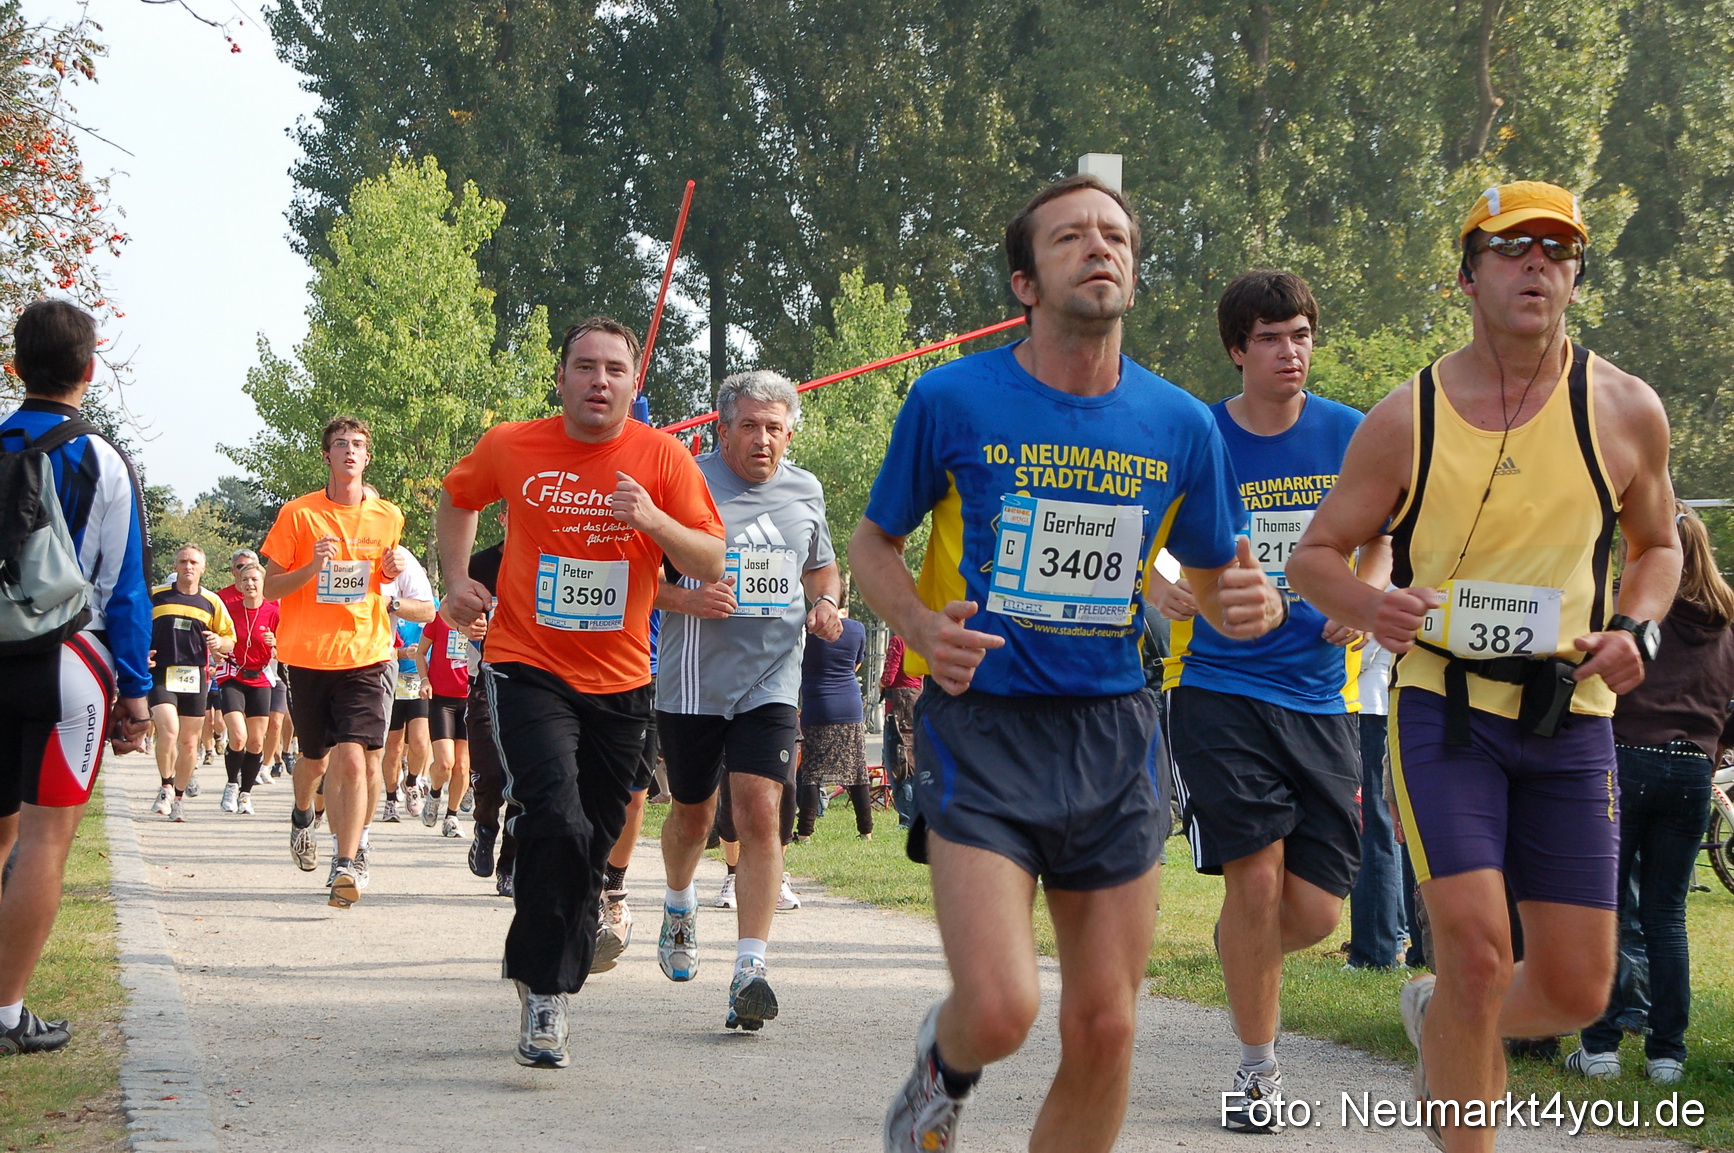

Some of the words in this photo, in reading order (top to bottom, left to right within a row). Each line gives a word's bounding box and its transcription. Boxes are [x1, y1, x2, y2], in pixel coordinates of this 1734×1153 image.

[983, 444, 1015, 464] 10.
[1021, 444, 1168, 482] NEUMARKTER
[1015, 467, 1142, 498] STADTLAUF
[539, 485, 615, 506] Fische
[1241, 490, 1322, 510] TADTLAUF
[547, 505, 615, 517] AUTOMOBIL
[562, 523, 580, 533] und
[583, 521, 600, 532] das
[1043, 511, 1116, 538] Gerhard
[1256, 518, 1301, 533] Thomas
[1005, 540, 1015, 555] C
[333, 564, 354, 573] Daniel
[563, 563, 594, 579] Peter
[744, 558, 769, 570] Josef
[1038, 547, 1123, 581] 3408
[334, 577, 364, 588] 2964
[542, 581, 548, 591] D
[745, 577, 789, 594] 3608
[562, 585, 617, 606] 3590
[1459, 587, 1539, 614] Hermann
[1078, 605, 1127, 616] PFLEIDERER
[1424, 616, 1433, 631] D
[1468, 623, 1534, 655] 382
[179, 675, 195, 684] 145
[81, 704, 96, 773] Giordana
